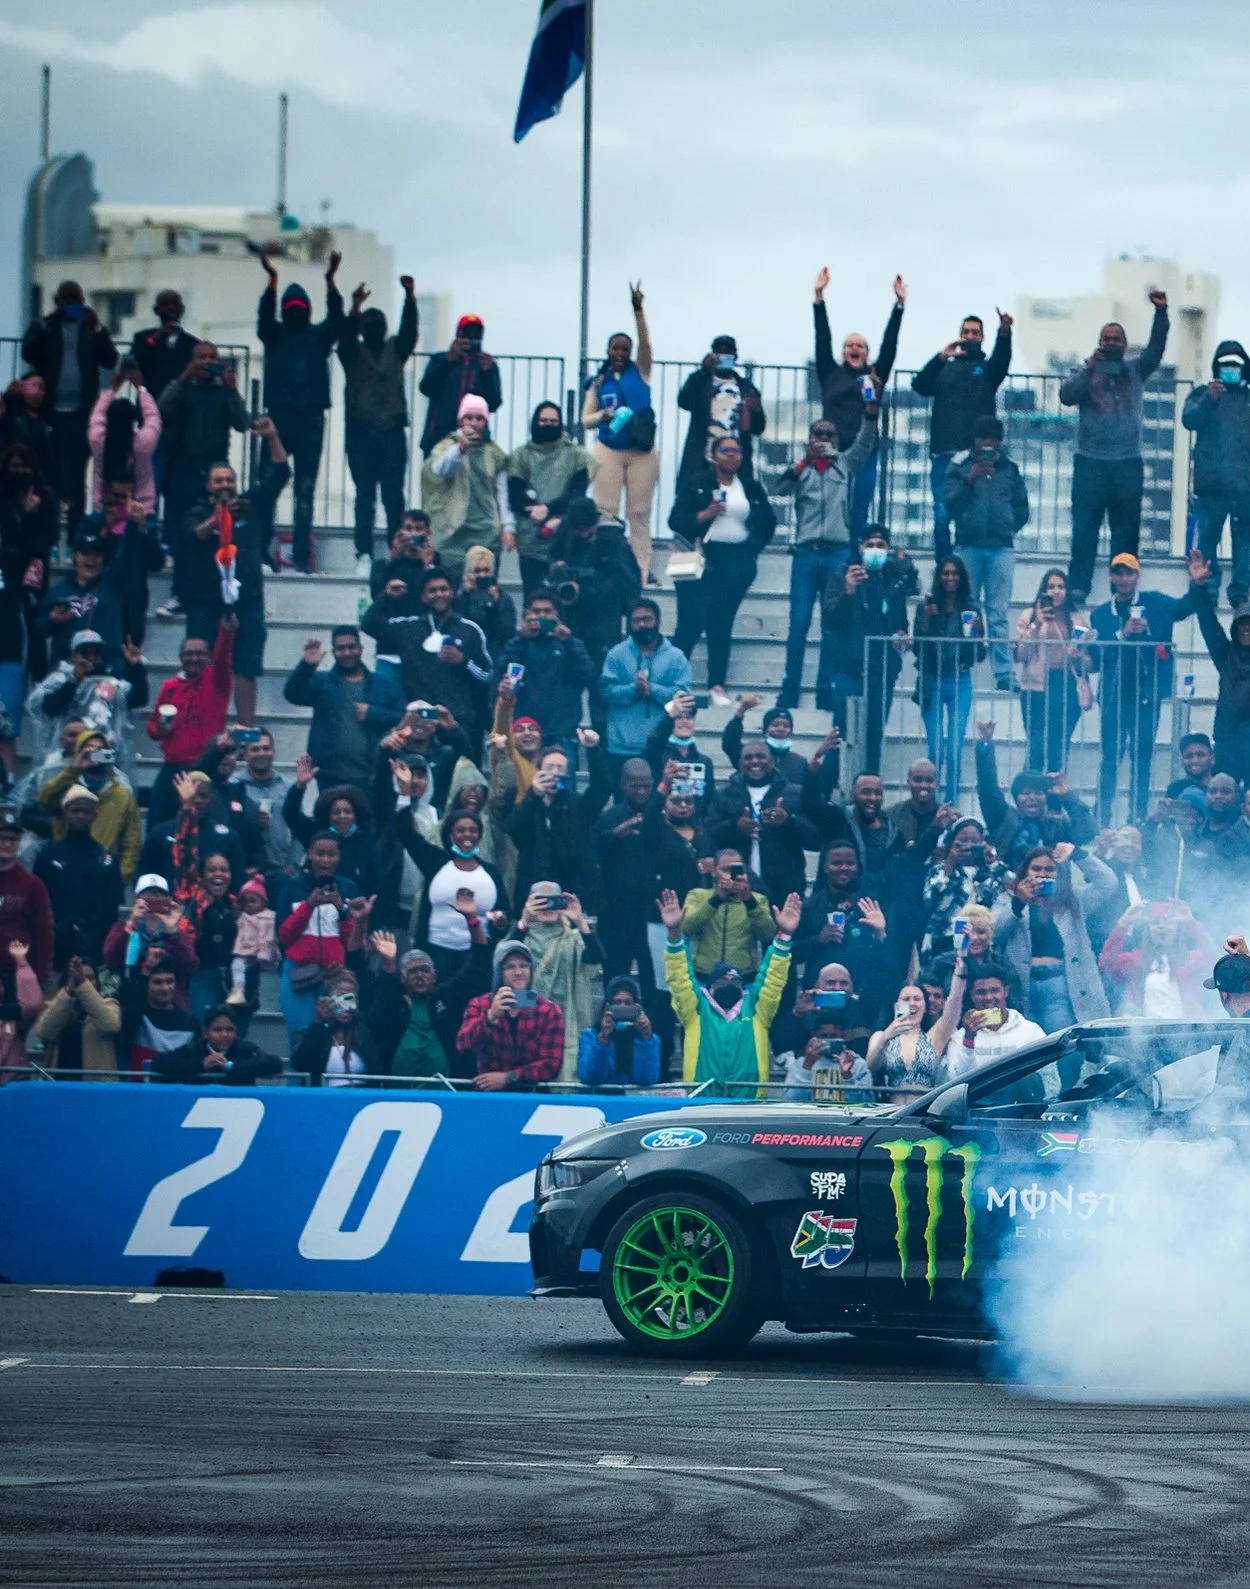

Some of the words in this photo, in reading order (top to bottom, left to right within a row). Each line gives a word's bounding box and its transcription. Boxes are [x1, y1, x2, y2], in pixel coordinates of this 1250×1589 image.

[652, 1131, 693, 1147] Ford
[712, 1132, 750, 1144] FORD
[751, 1133, 863, 1147] PERFORMANCE
[810, 1171, 847, 1188] SUPA
[986, 1183, 1125, 1221] MONST
